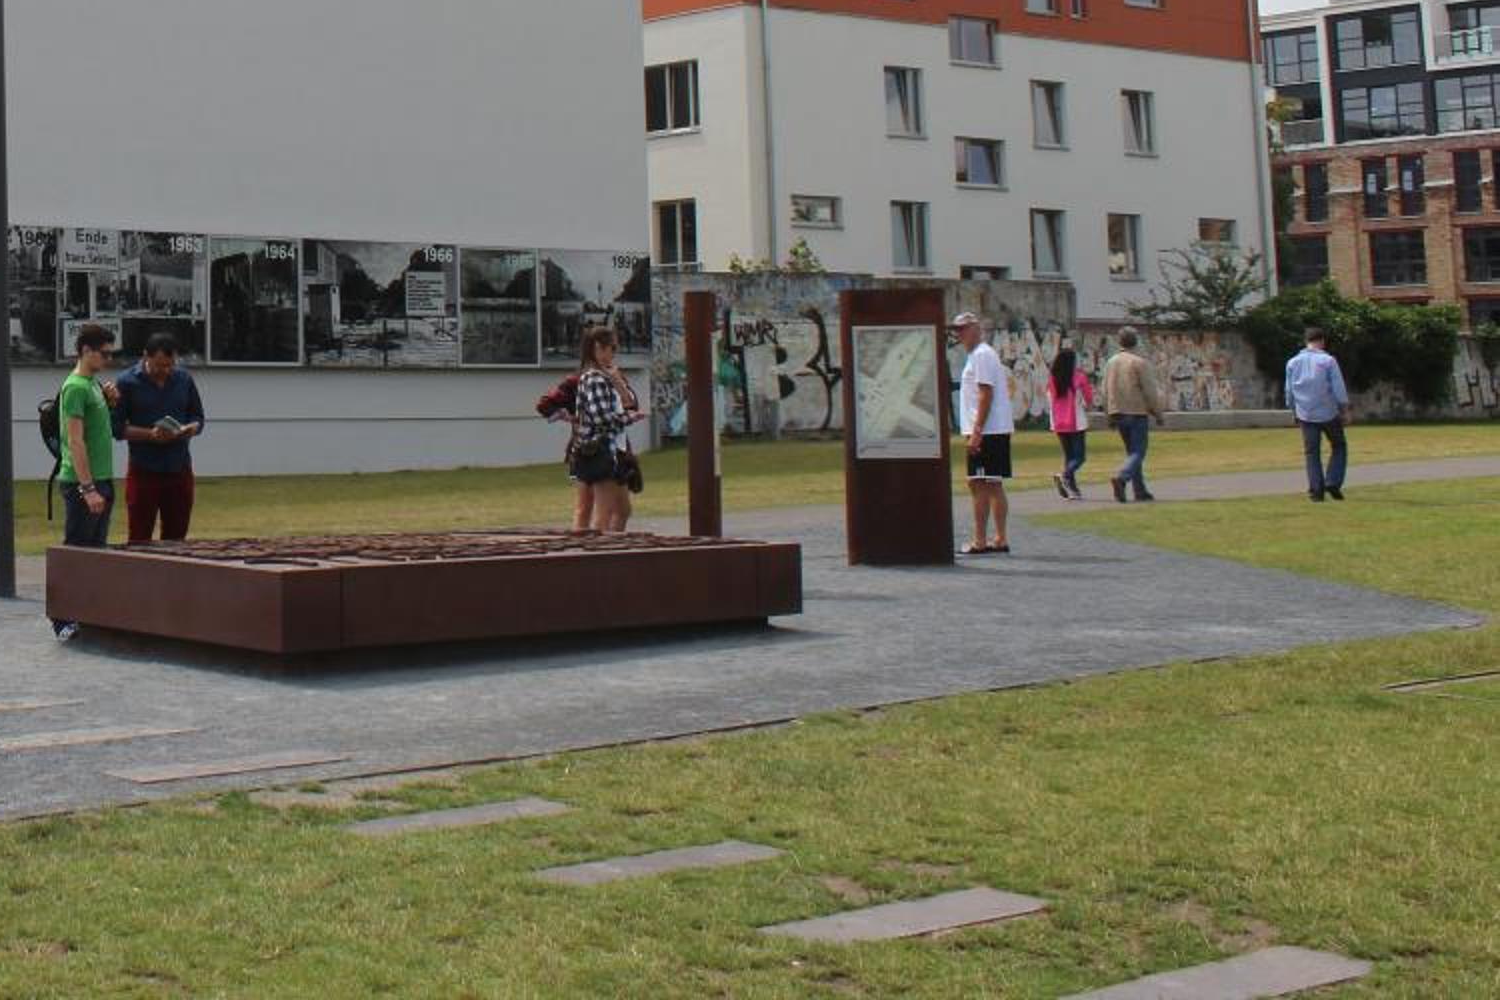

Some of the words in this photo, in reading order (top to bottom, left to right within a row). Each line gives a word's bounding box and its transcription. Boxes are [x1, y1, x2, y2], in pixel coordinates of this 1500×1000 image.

[75, 227, 108, 245] Ende
[168, 236, 203, 253] 1963
[264, 243, 296, 260] 1964
[422, 247, 454, 263] 1966
